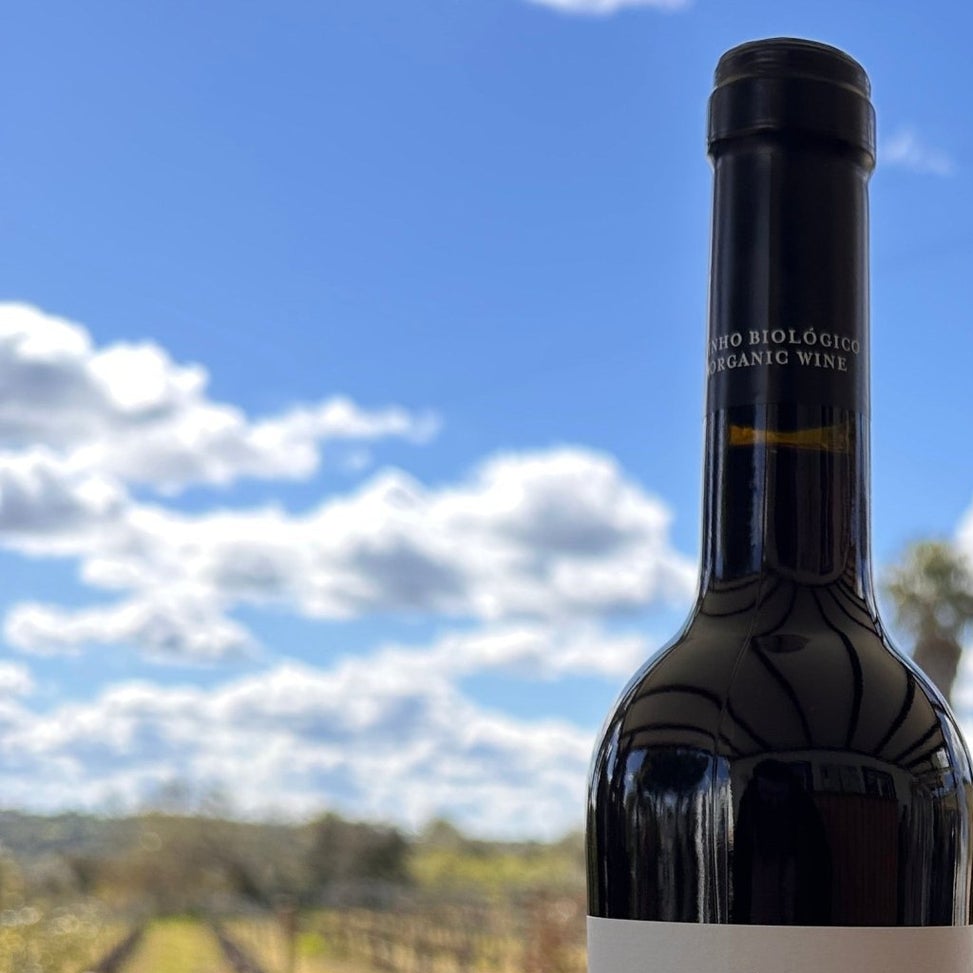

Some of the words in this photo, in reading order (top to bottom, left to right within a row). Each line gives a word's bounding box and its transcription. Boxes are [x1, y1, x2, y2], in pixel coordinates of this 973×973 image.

[749, 327, 861, 355] BIOLÓGICO
[708, 350, 789, 376] ORGANIC
[797, 351, 848, 372] WINE
